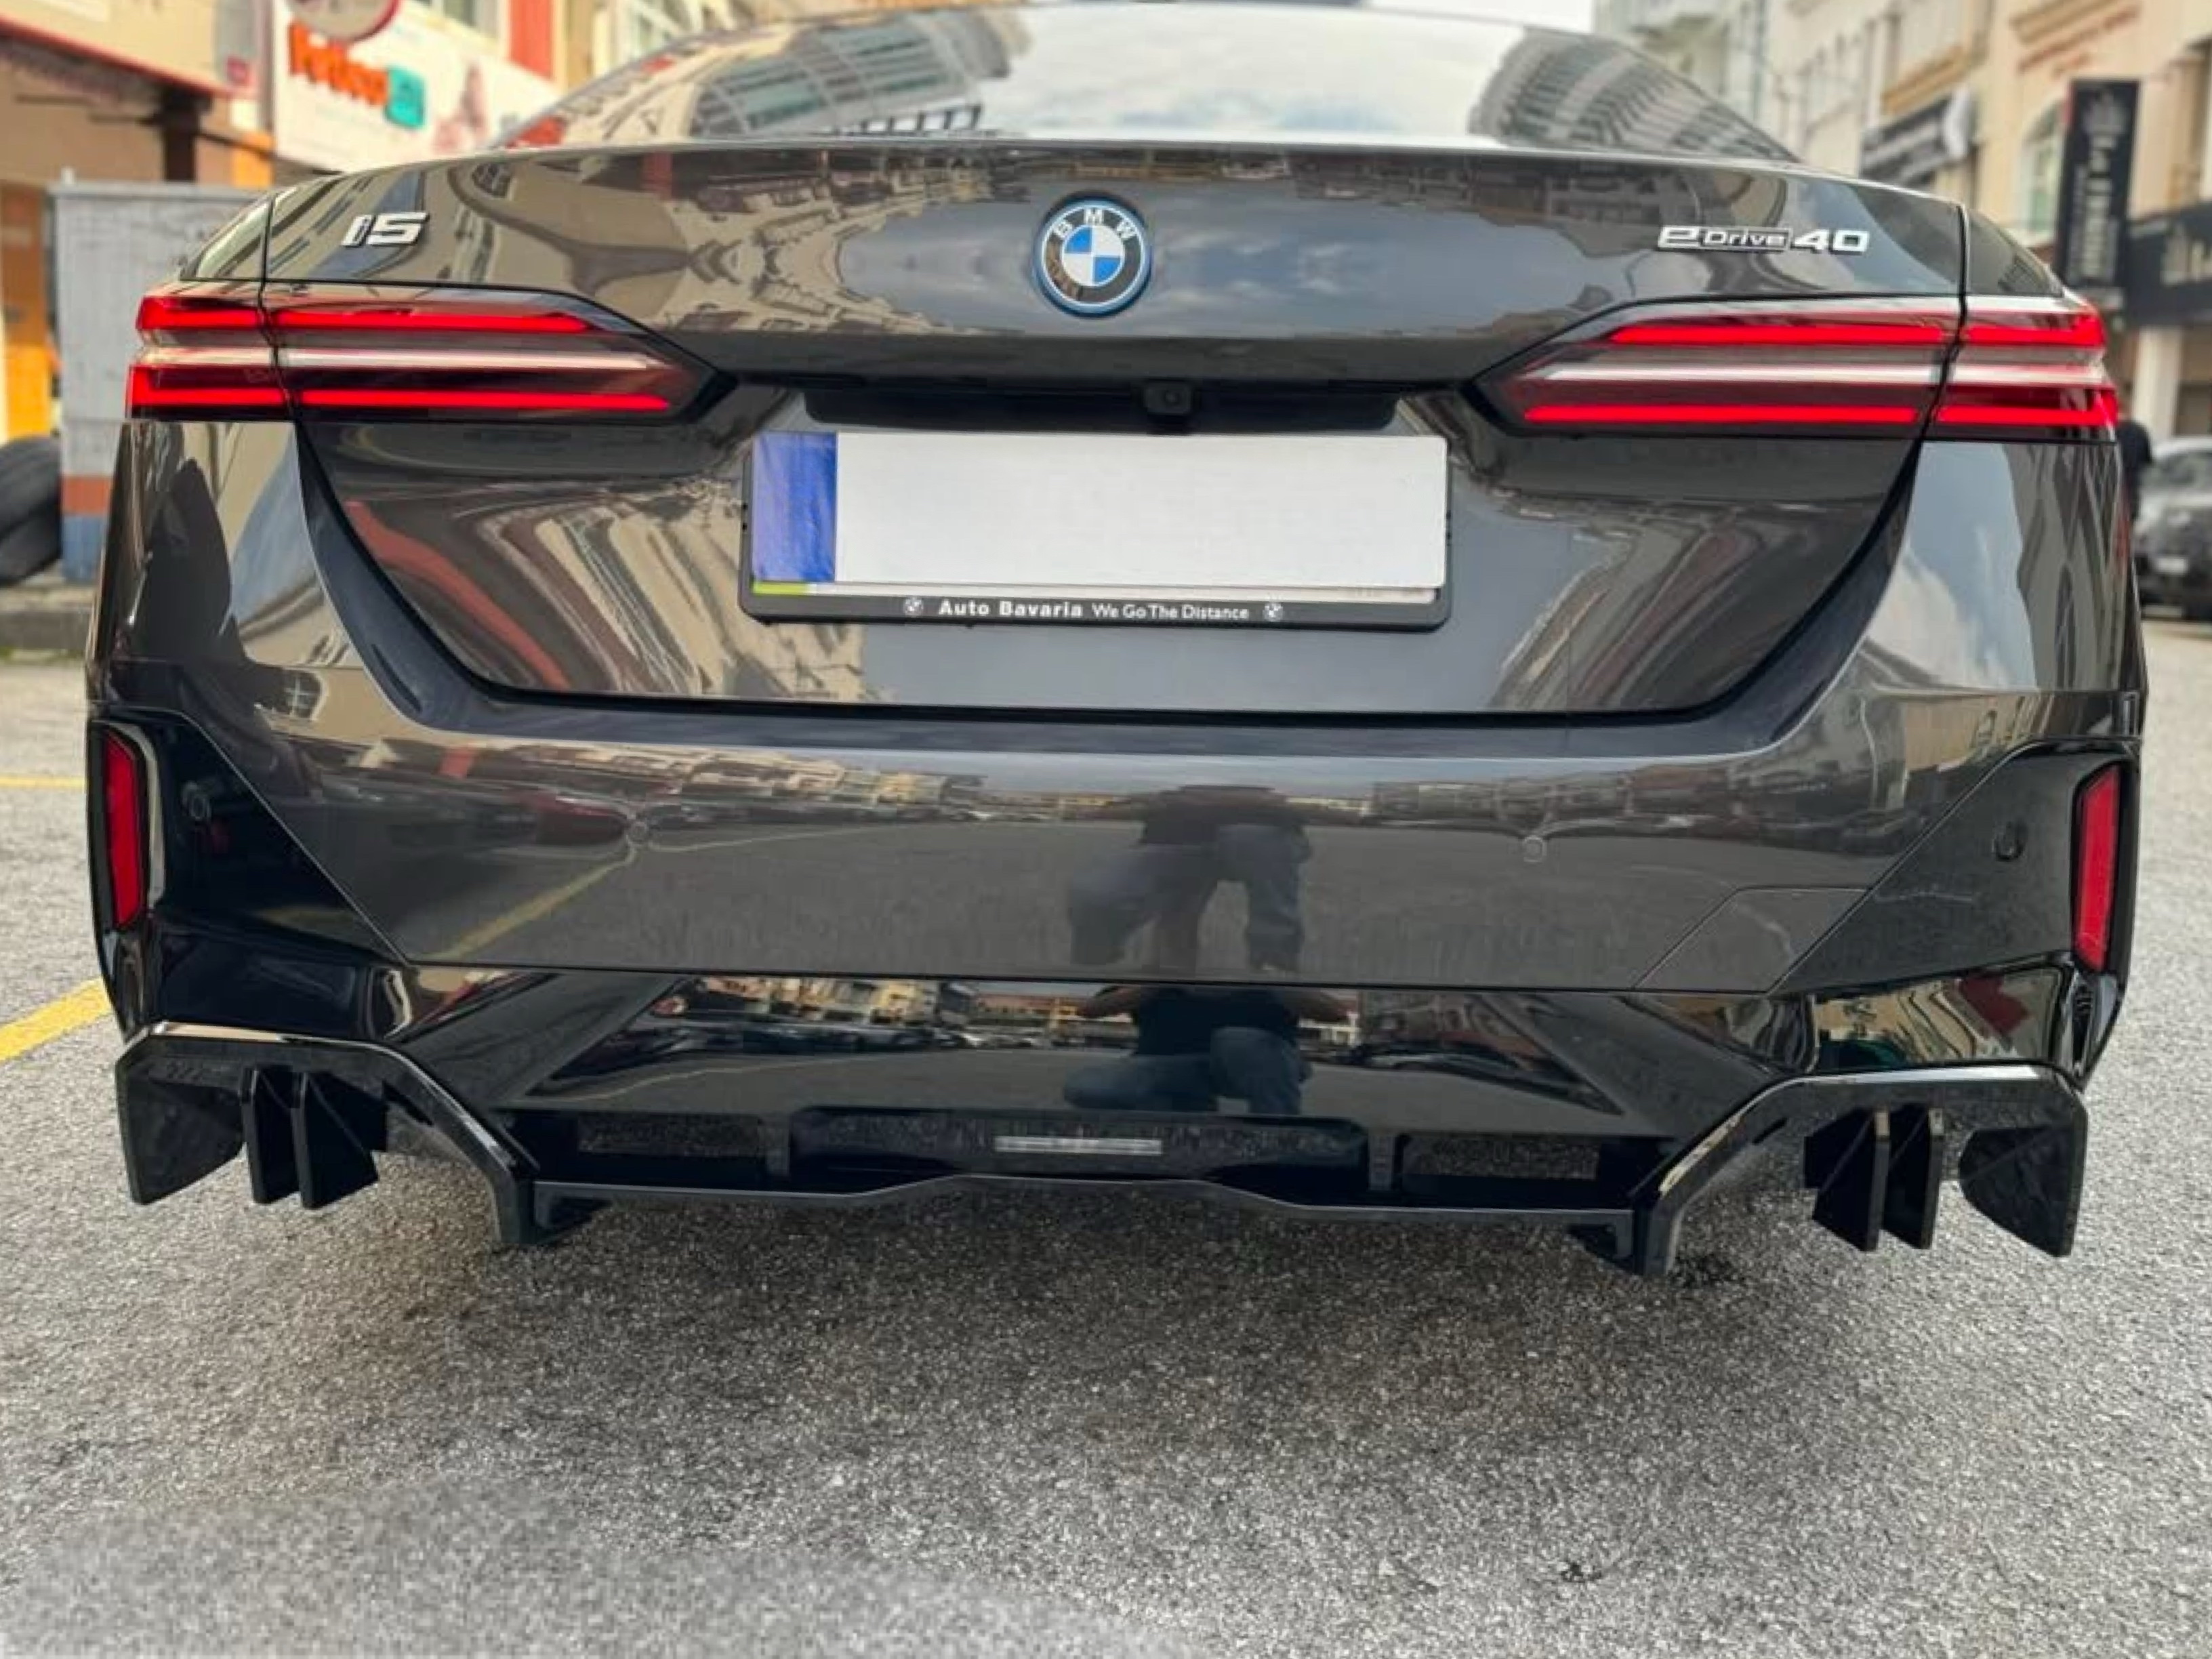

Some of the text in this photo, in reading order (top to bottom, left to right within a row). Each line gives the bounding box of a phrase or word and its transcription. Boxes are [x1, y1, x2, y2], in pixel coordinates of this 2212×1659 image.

[341, 211, 426, 246] i5
[1050, 207, 1139, 241] BMW
[939, 599, 1249, 620] Auto Bavaria We Go The Distance
